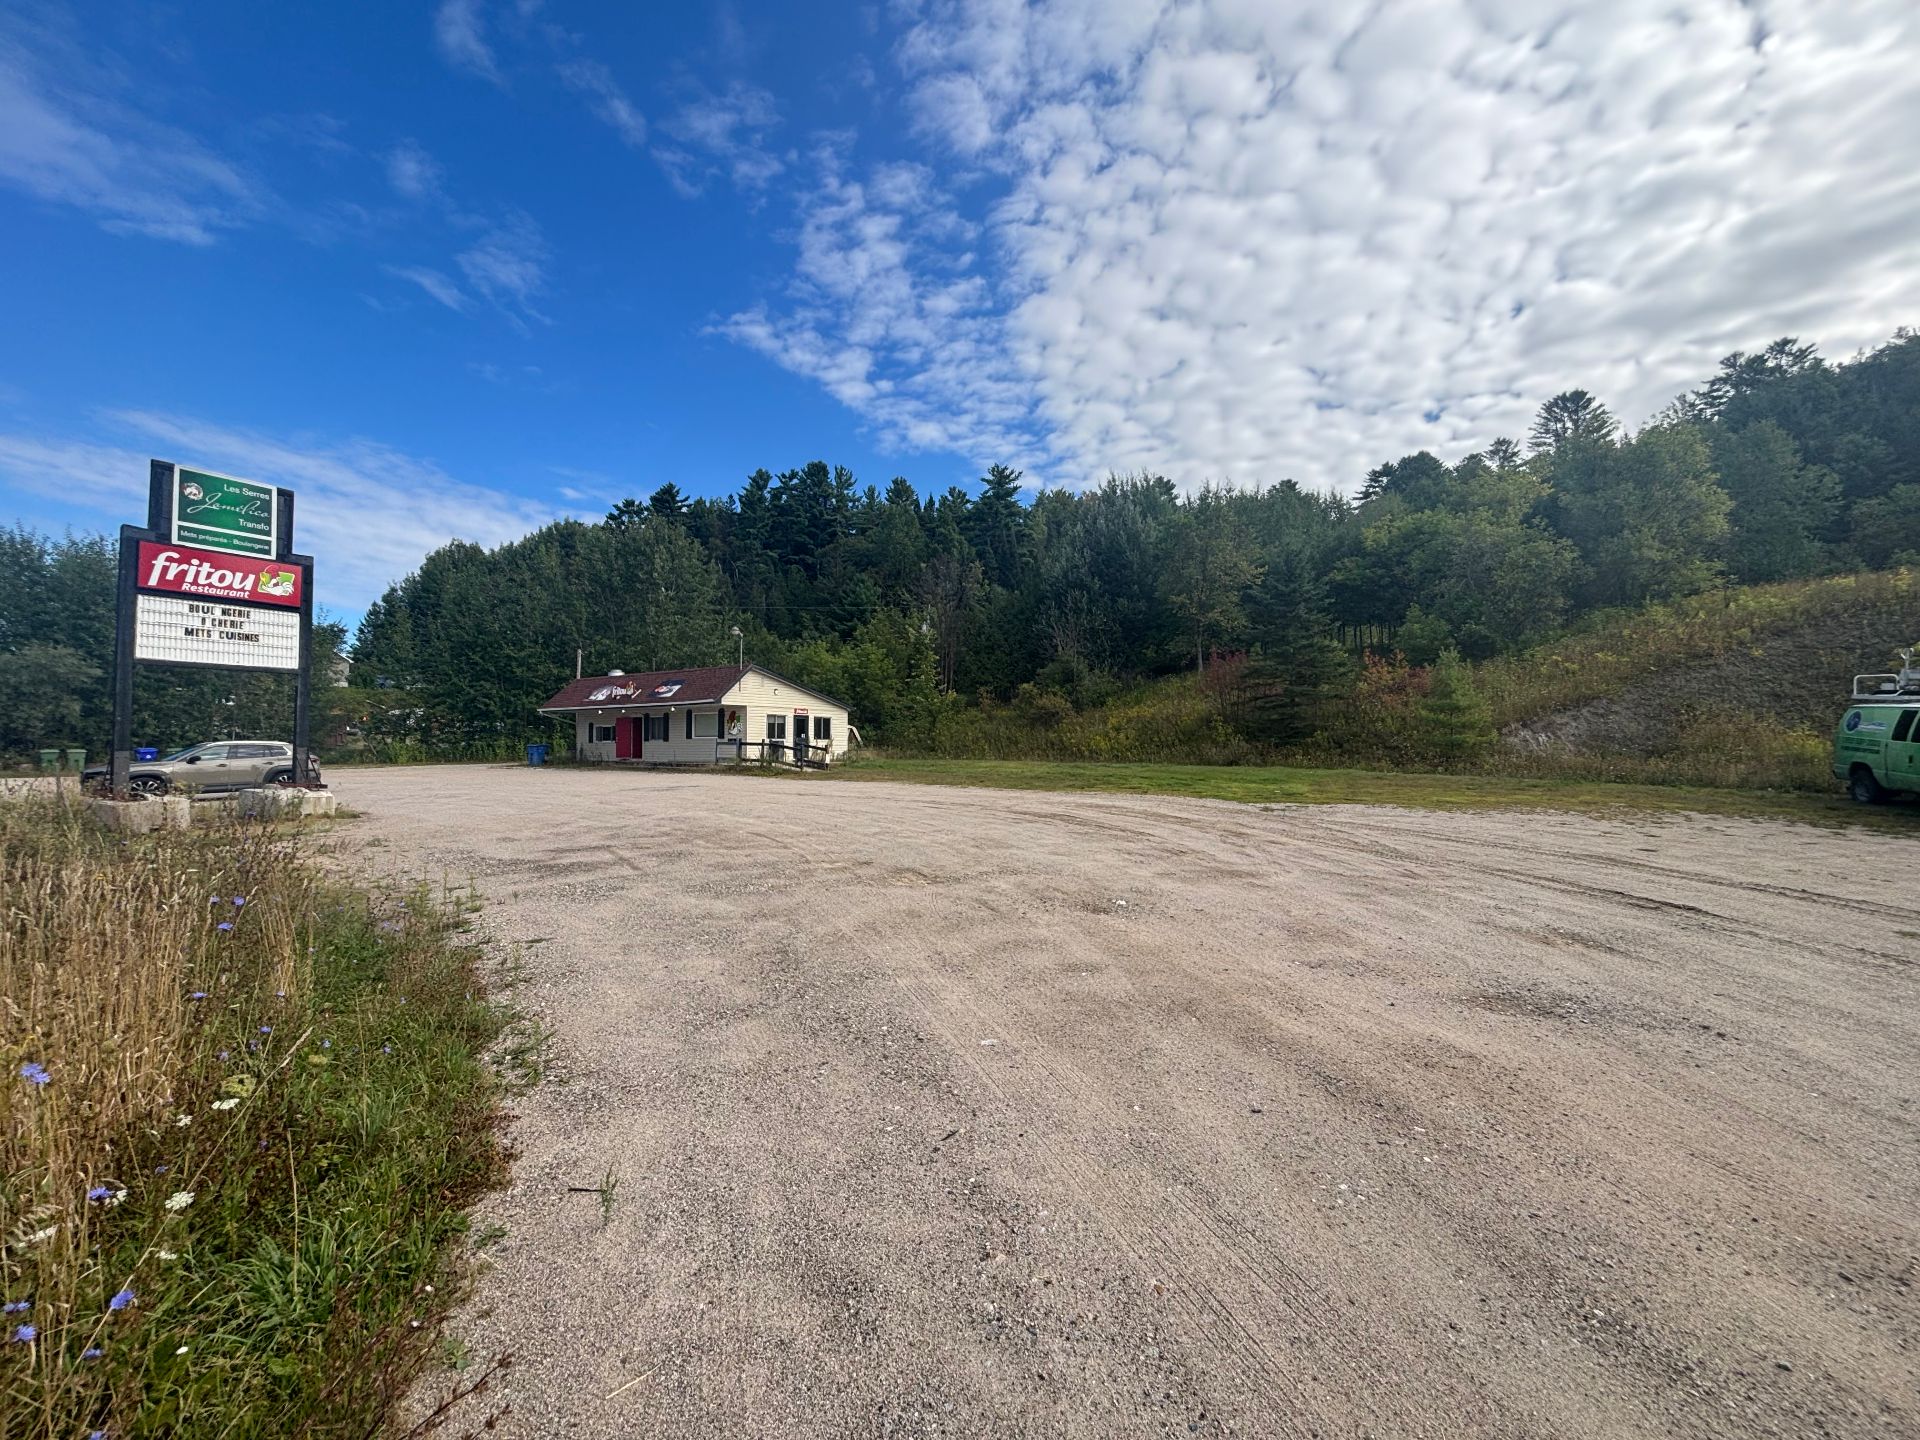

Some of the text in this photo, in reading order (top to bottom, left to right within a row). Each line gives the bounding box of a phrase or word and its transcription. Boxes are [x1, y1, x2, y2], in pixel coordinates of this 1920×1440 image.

[223, 483, 270, 501] Les Serres
[238, 518, 270, 531] Transfo
[180, 530, 198, 538] Mets
[147, 551, 256, 591] fritou
[181, 583, 251, 599] Restaurant
[221, 607, 252, 619] NGERIE
[211, 618, 245, 630] CHERIE
[184, 627, 260, 643] METS CUISINES
